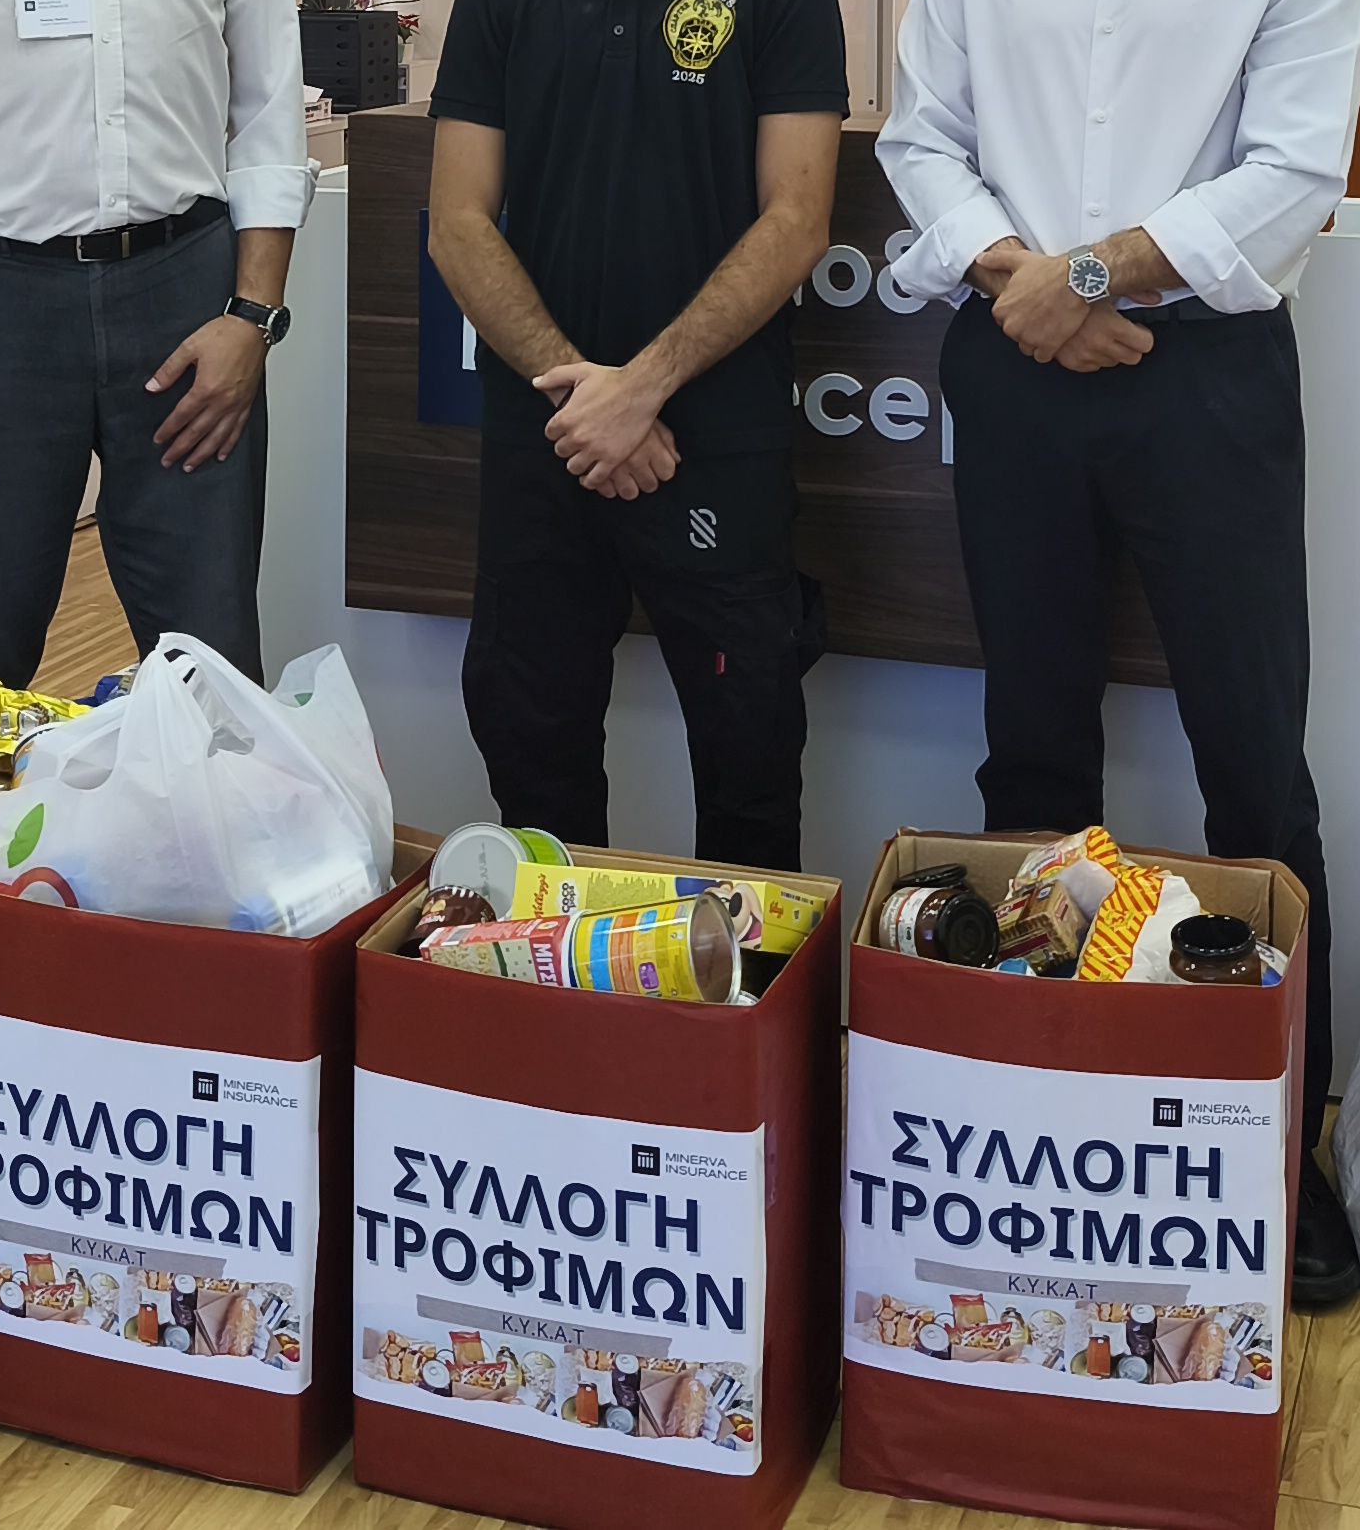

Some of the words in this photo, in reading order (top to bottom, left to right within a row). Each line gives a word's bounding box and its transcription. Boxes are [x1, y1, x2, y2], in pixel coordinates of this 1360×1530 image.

[672, 69, 706, 85] 2025
[223, 1078, 280, 1095] MINERVA
[223, 1091, 299, 1109] INSURANCE
[1188, 1102, 1252, 1115] MINERVA
[1188, 1113, 1272, 1127] INSURANCE
[665, 1152, 728, 1169] MINERVA
[891, 1110, 1222, 1199] ΣΥΛΛΟΓΗ
[665, 1164, 748, 1182] INSURANCE
[393, 1145, 700, 1253] ΣΥΛΛΟΓΗ
[849, 1168, 1267, 1272] ΤΡΟΦΙΜΩΝ
[356, 1204, 744, 1331] ΤΡΟΦΙΜΩΝ
